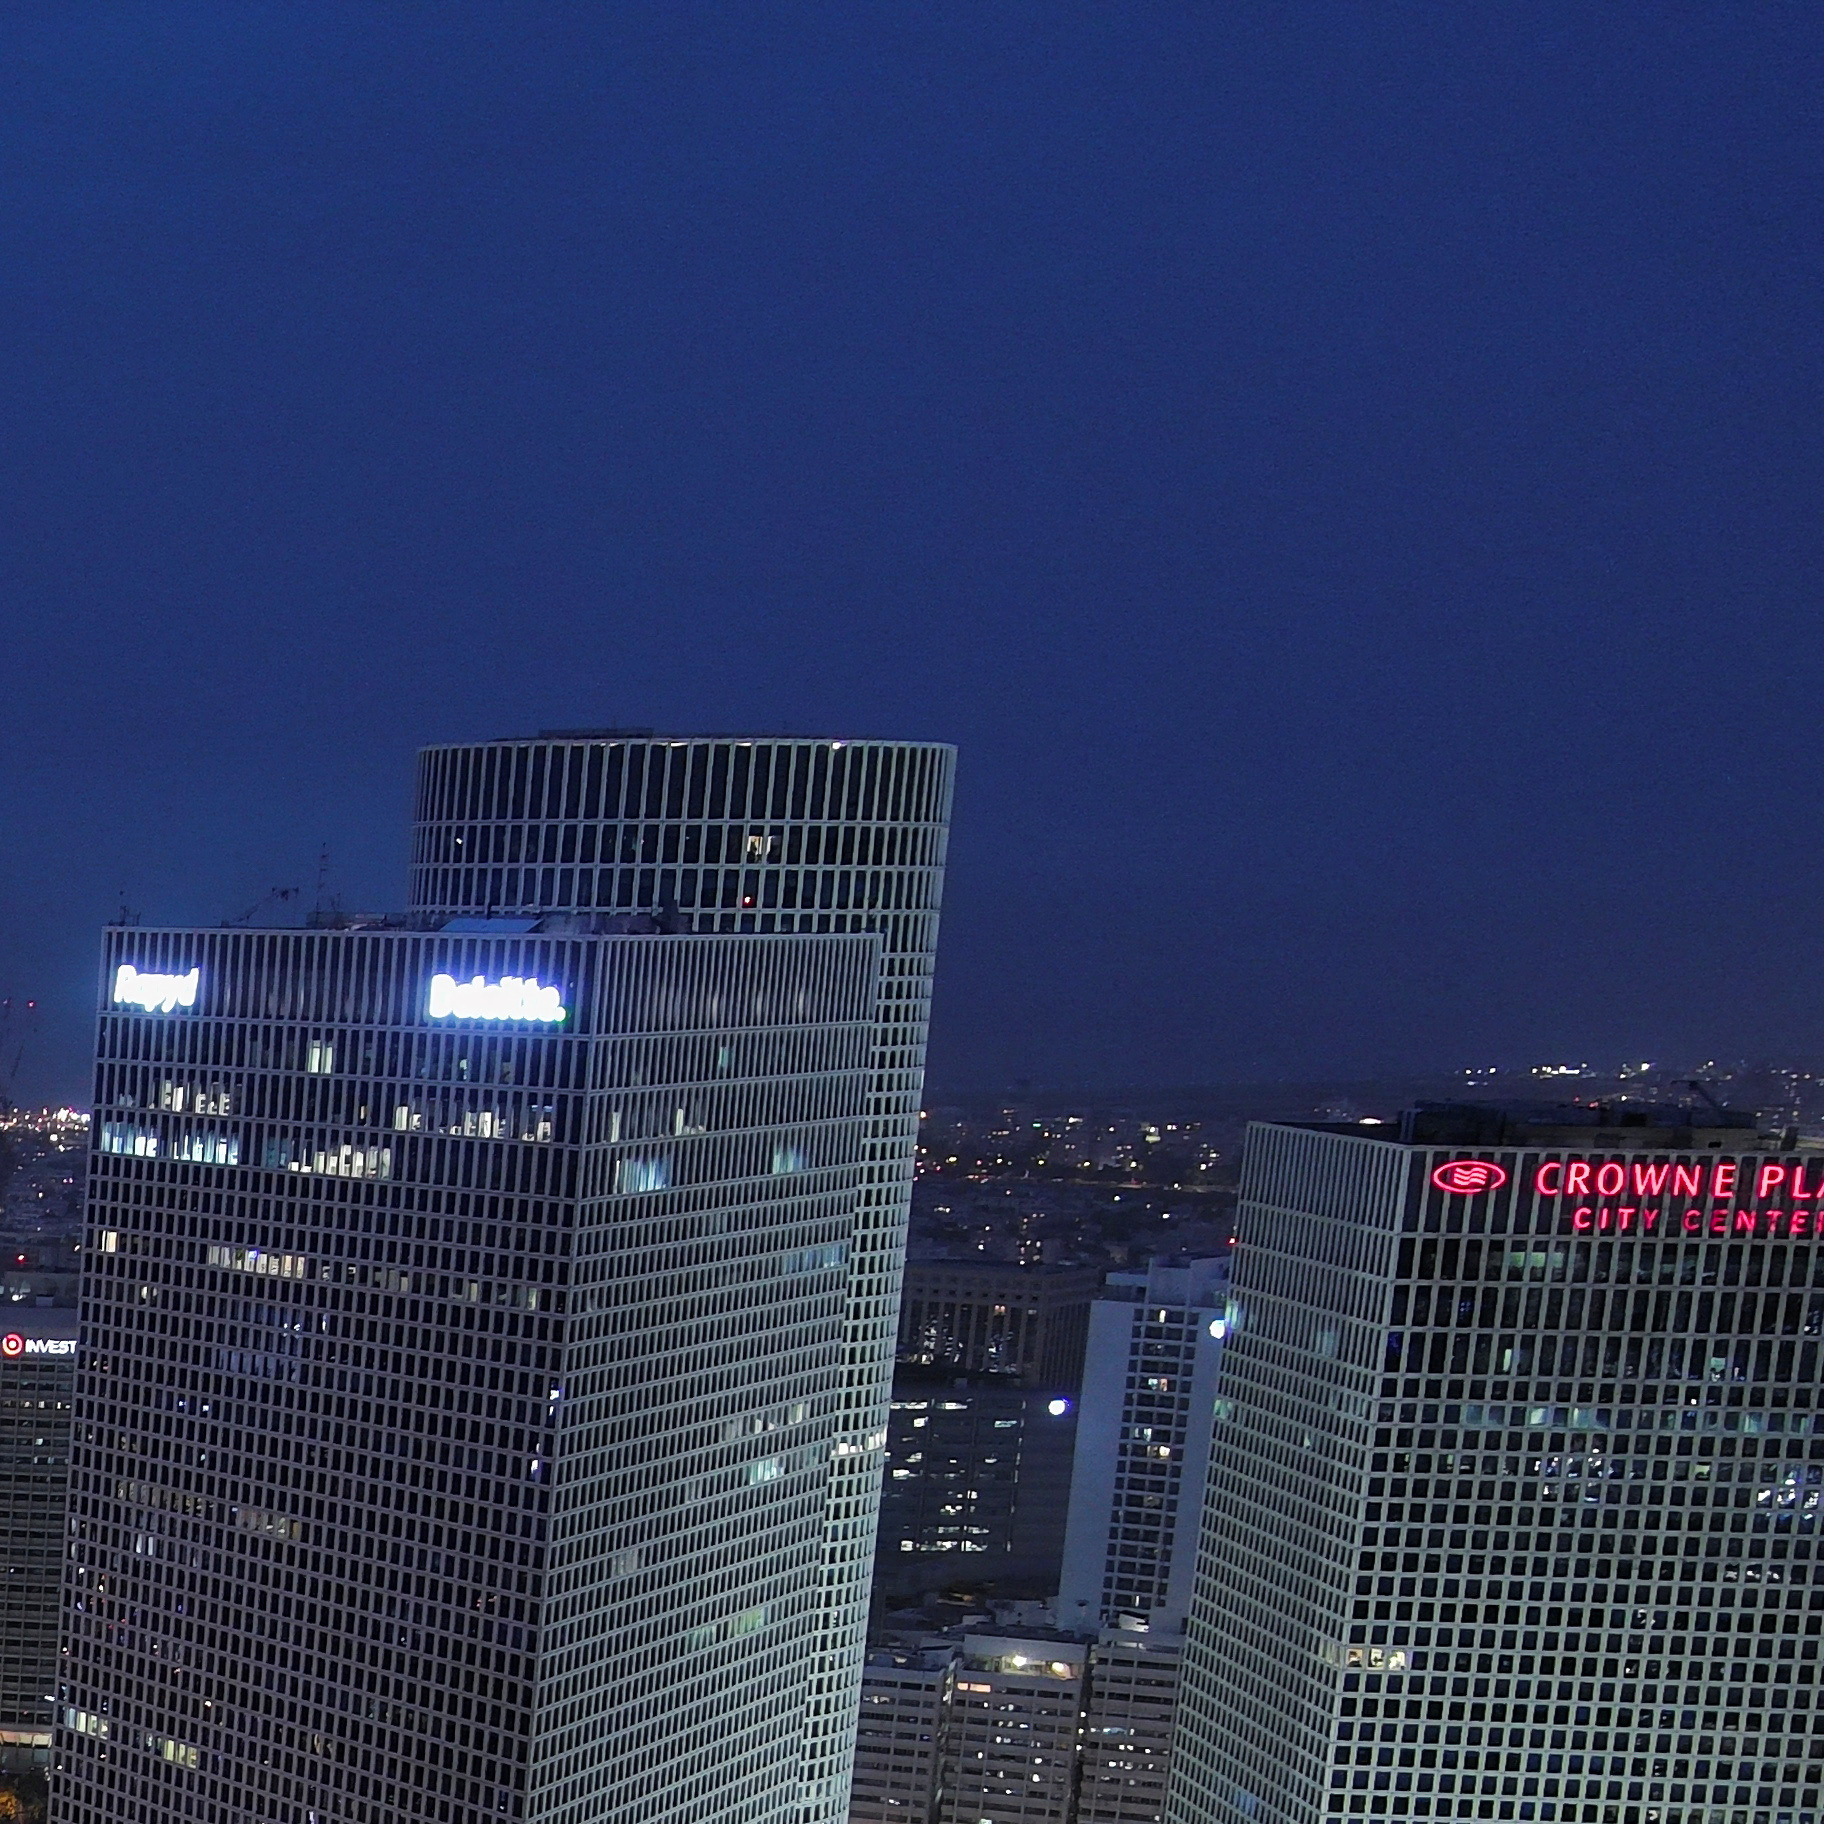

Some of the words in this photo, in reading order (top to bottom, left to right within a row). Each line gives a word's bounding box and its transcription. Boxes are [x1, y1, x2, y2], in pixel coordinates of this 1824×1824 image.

[1537, 1162, 1736, 1198] CROWNE
[1759, 1165, 1824, 1198] PL
[1573, 1207, 1660, 1230] CITY
[25, 1339, 77, 1355] INVEST
